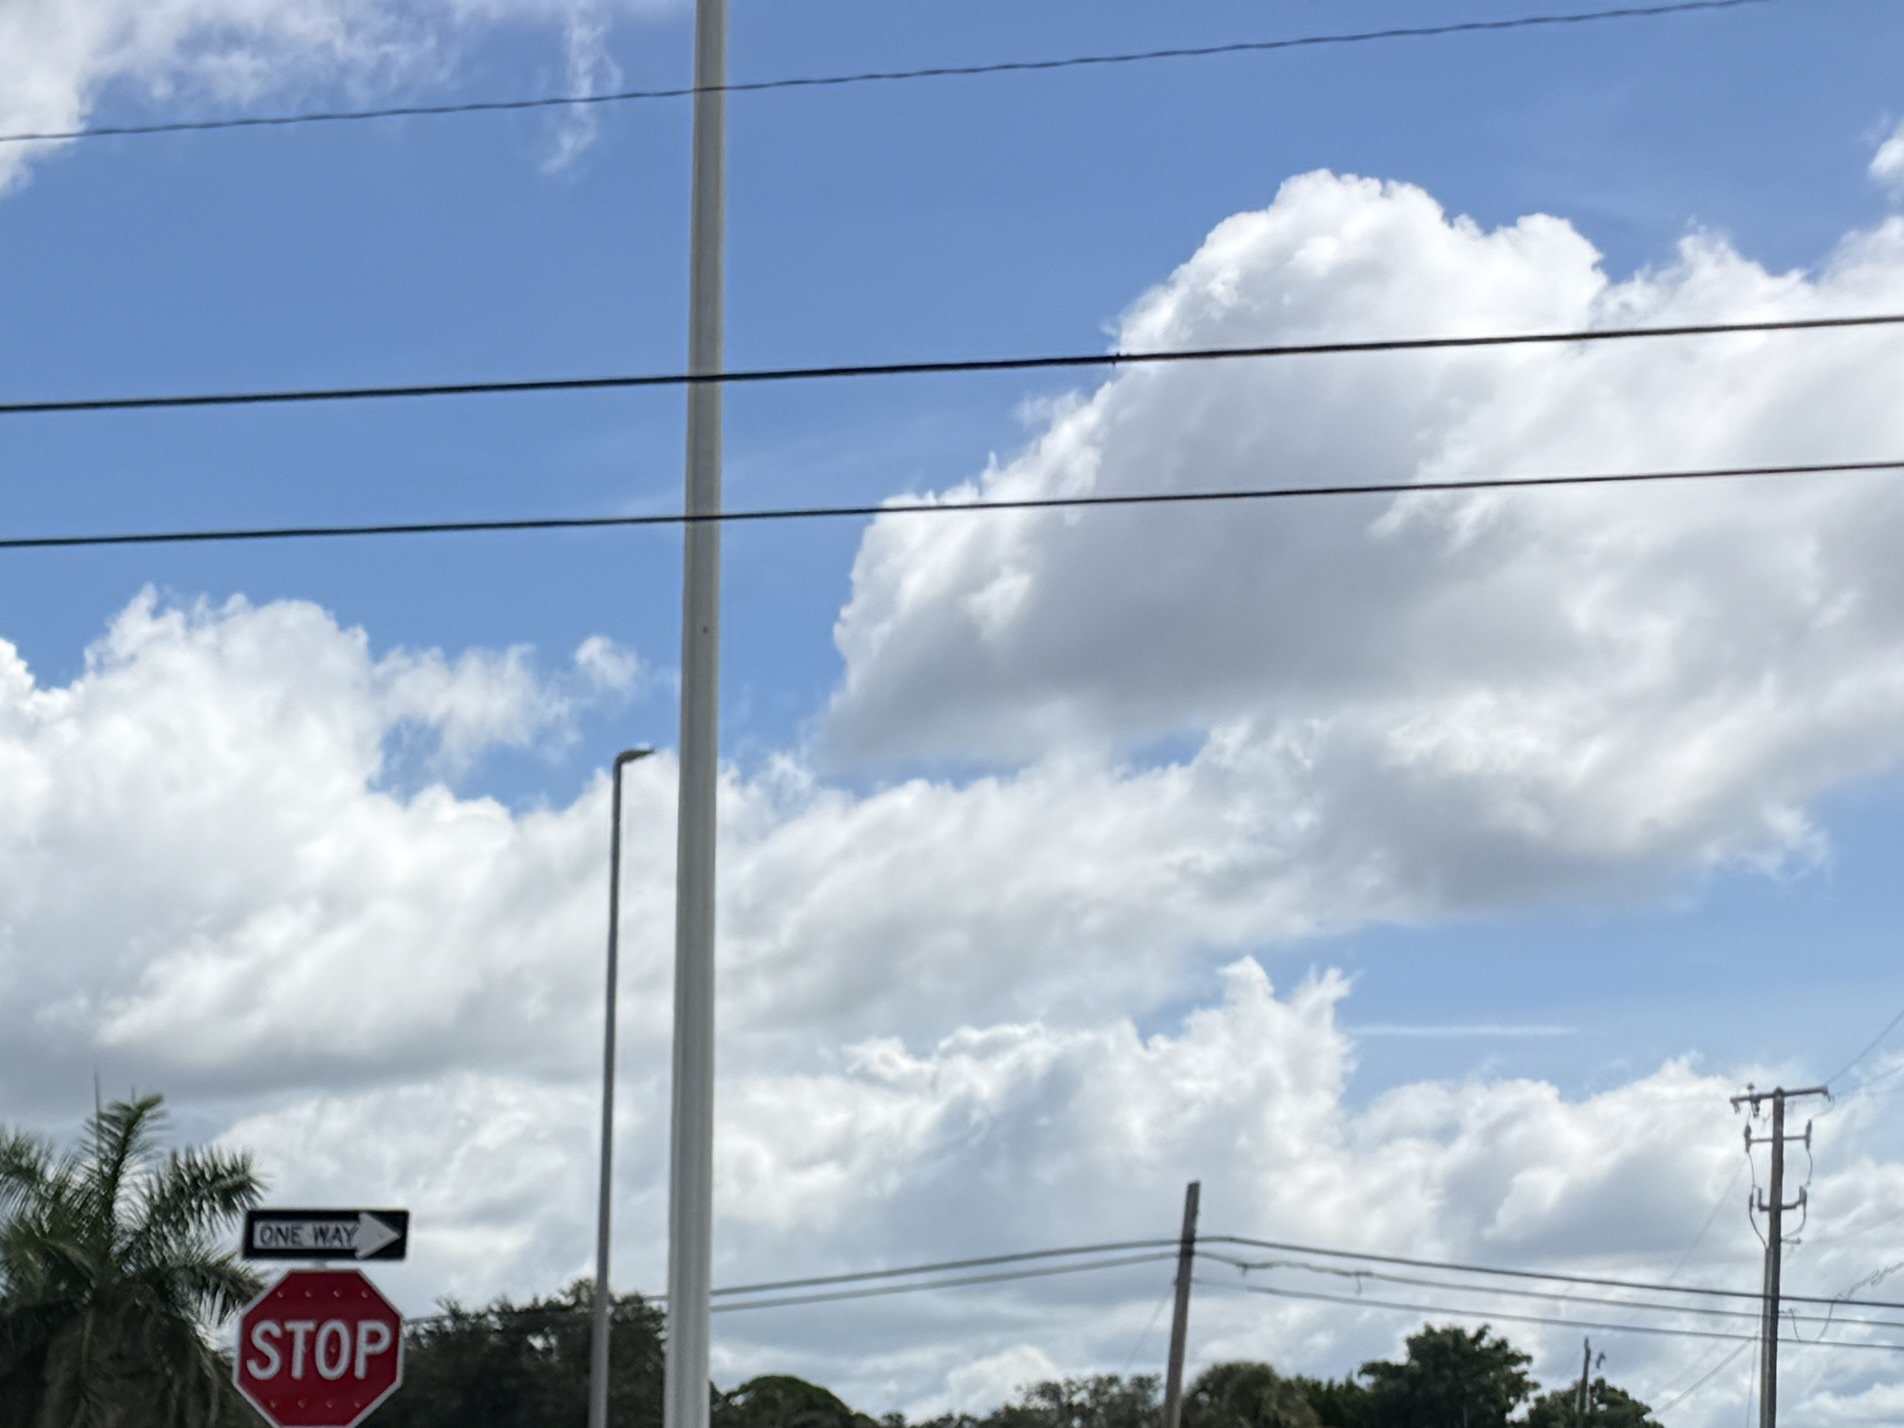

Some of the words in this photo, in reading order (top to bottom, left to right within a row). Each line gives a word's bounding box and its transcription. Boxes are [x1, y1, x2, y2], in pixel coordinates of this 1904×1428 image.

[259, 1224, 304, 1247] ONE
[312, 1224, 358, 1248] WAY
[246, 1319, 391, 1380] STOP
